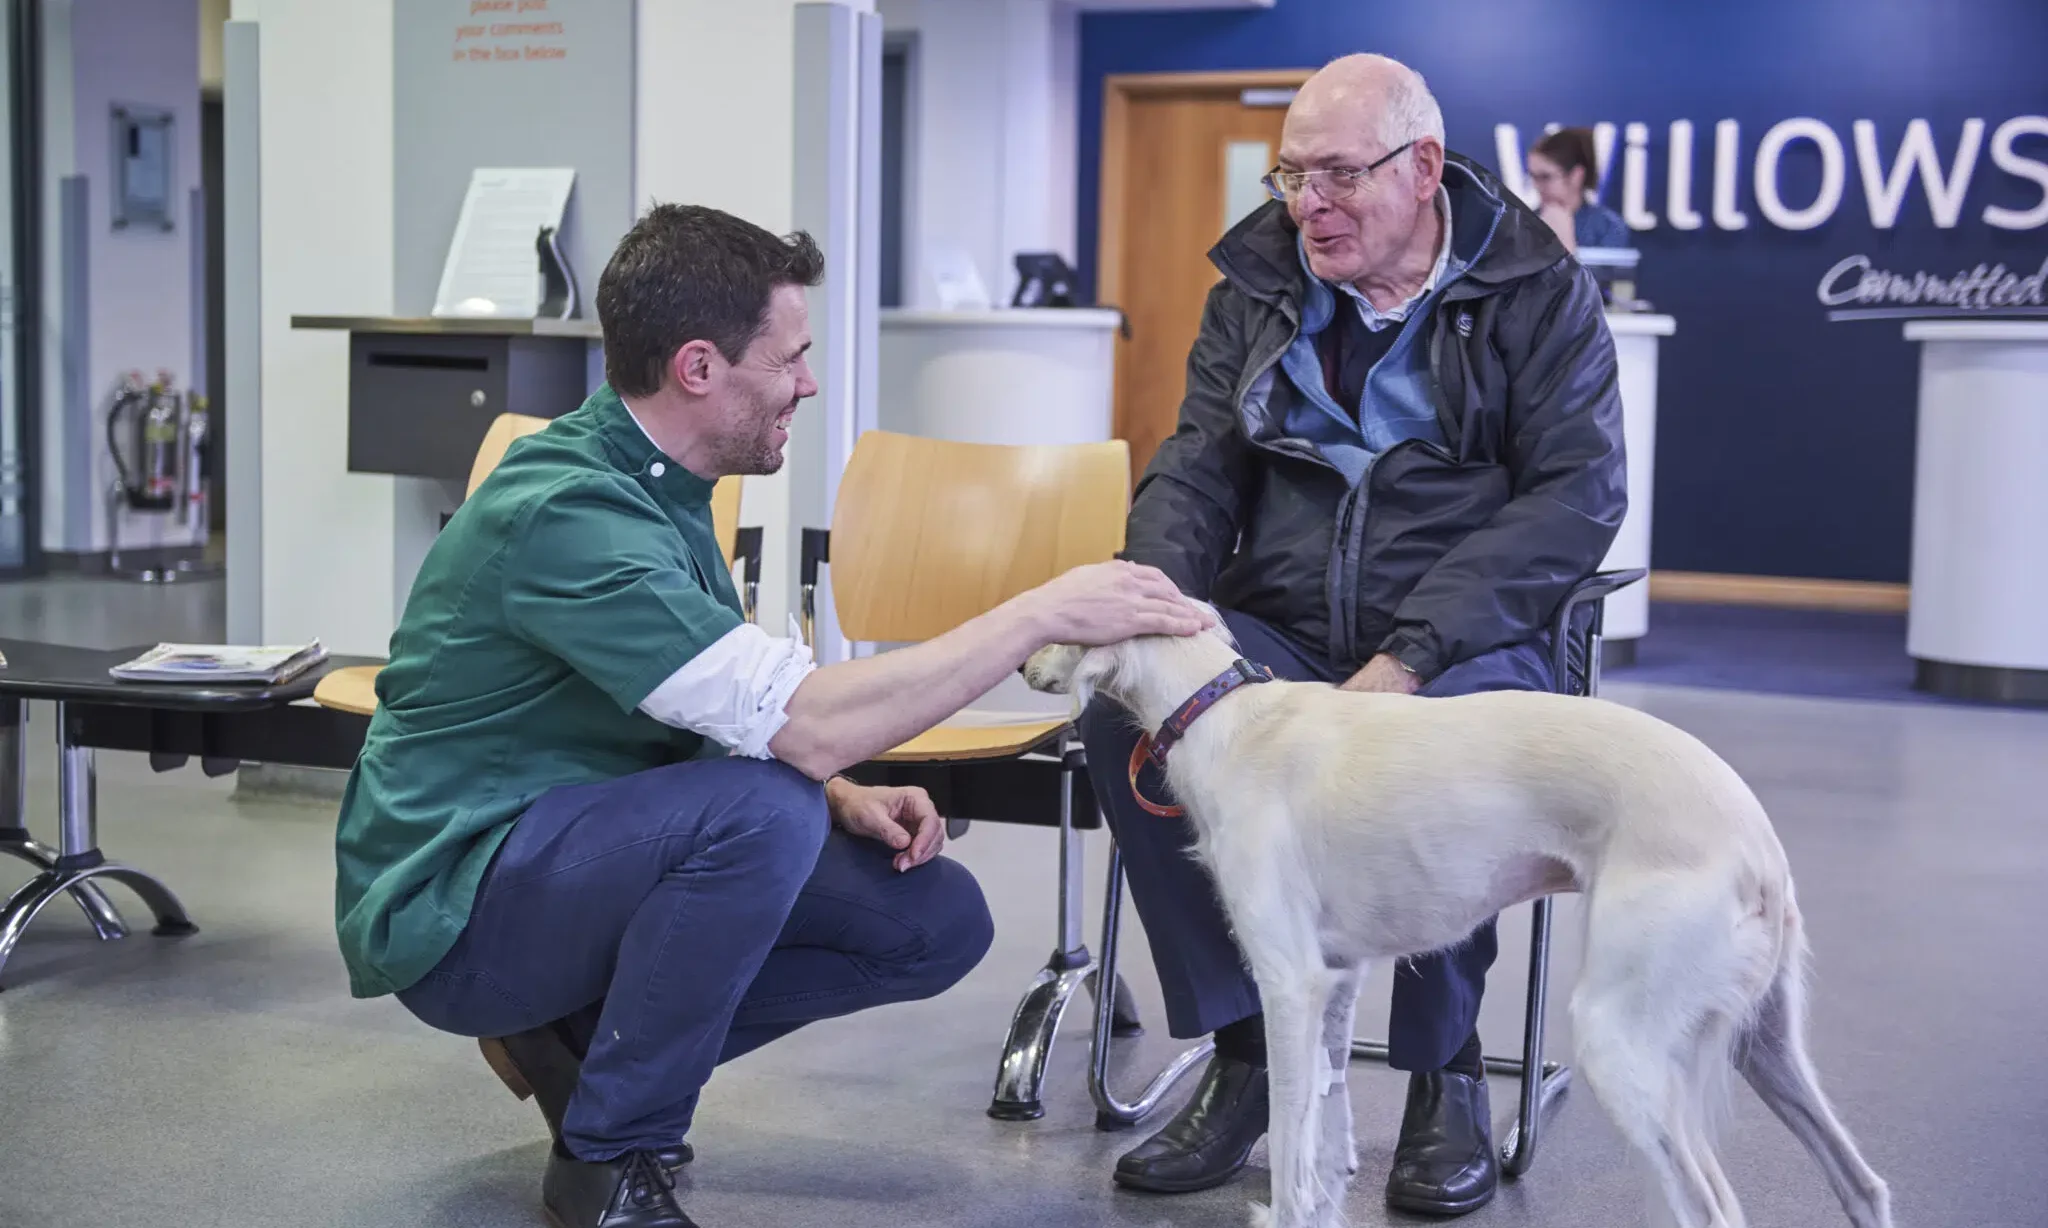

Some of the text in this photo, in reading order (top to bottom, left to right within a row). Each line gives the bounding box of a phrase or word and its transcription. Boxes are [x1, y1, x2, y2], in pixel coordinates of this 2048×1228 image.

[455, 25, 486, 42] your
[469, 47, 492, 61] the
[495, 45, 519, 60] box
[524, 45, 567, 60] below
